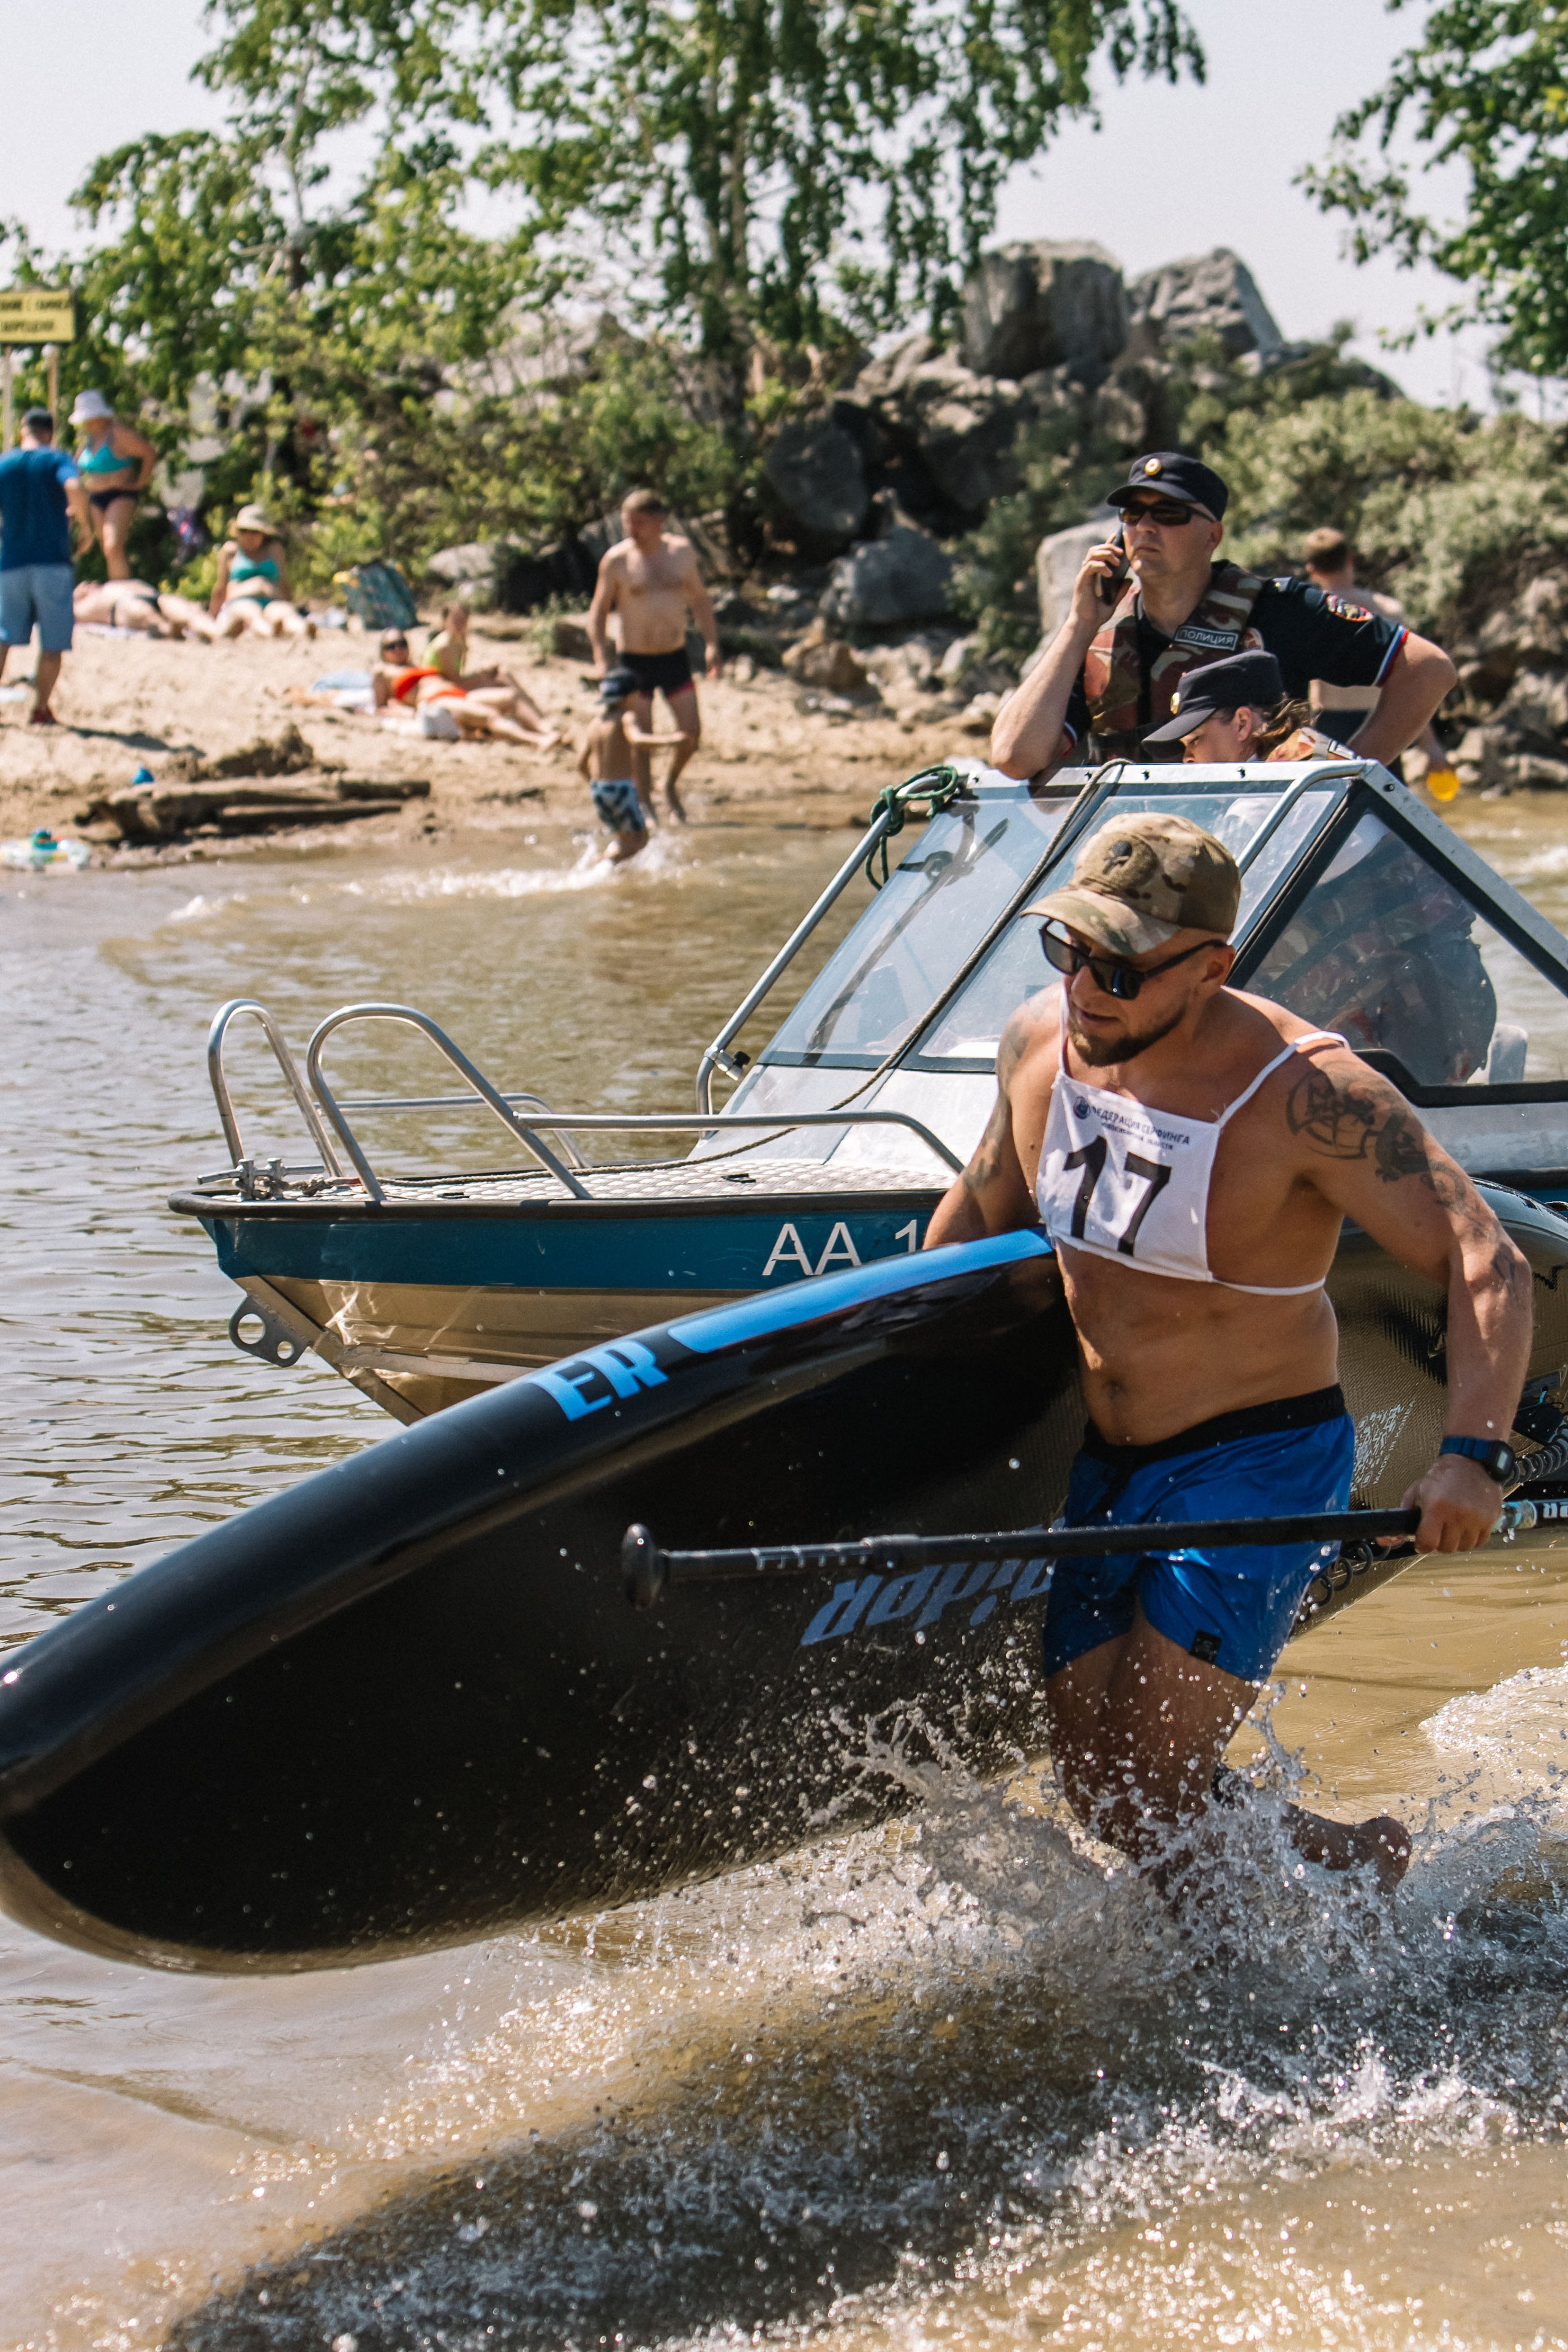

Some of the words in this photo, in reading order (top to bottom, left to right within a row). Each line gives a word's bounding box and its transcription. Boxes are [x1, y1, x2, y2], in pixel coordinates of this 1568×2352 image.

[1179, 630, 1234, 646] ПОЛИЦИЯ
[1063, 1134, 1172, 1257] 17
[530, 1339, 669, 1422] ER
[1373, 1453, 1390, 1485] MADE
[1388, 1440, 1397, 1451] IN
[1394, 1401, 1415, 1438] KOREA
